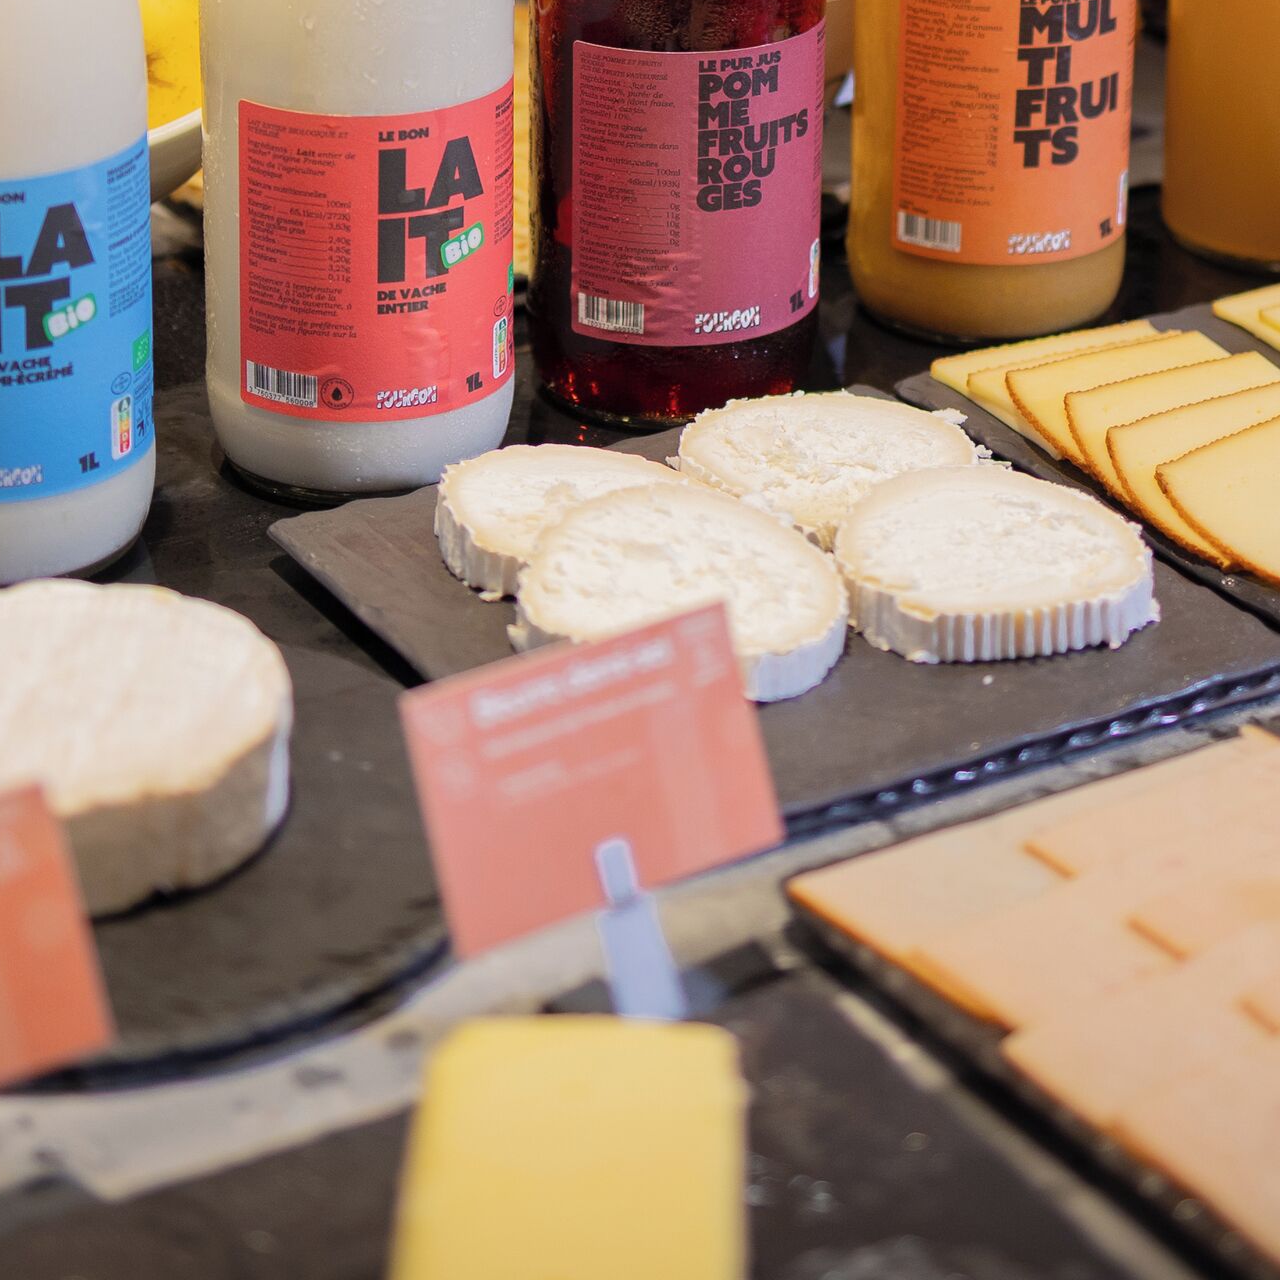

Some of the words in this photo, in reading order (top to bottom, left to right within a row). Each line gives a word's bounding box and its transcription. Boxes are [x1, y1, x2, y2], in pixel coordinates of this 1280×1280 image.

[698, 60, 717, 72] LE
[720, 57, 753, 72] PUR
[756, 51, 781, 67] JUS
[1017, 45, 1072, 86] TI
[698, 65, 779, 101] POM
[698, 99, 749, 130] ME
[1015, 72, 1118, 128] FRUI
[378, 131, 395, 142] LE
[398, 127, 429, 141] BON
[698, 108, 808, 157] FRUITS
[1014, 126, 1078, 168] TS
[378, 136, 484, 215] LA
[697, 148, 776, 185] ROU
[696, 179, 762, 212] GES
[377, 206, 464, 283] IT
[377, 290, 396, 302] DE
[400, 283, 447, 300] VACHE
[377, 301, 429, 315] ENTIER
[466, 371, 483, 392] 1L
[286, 396, 314, 407] 560008
[79, 451, 99, 473] 1L
